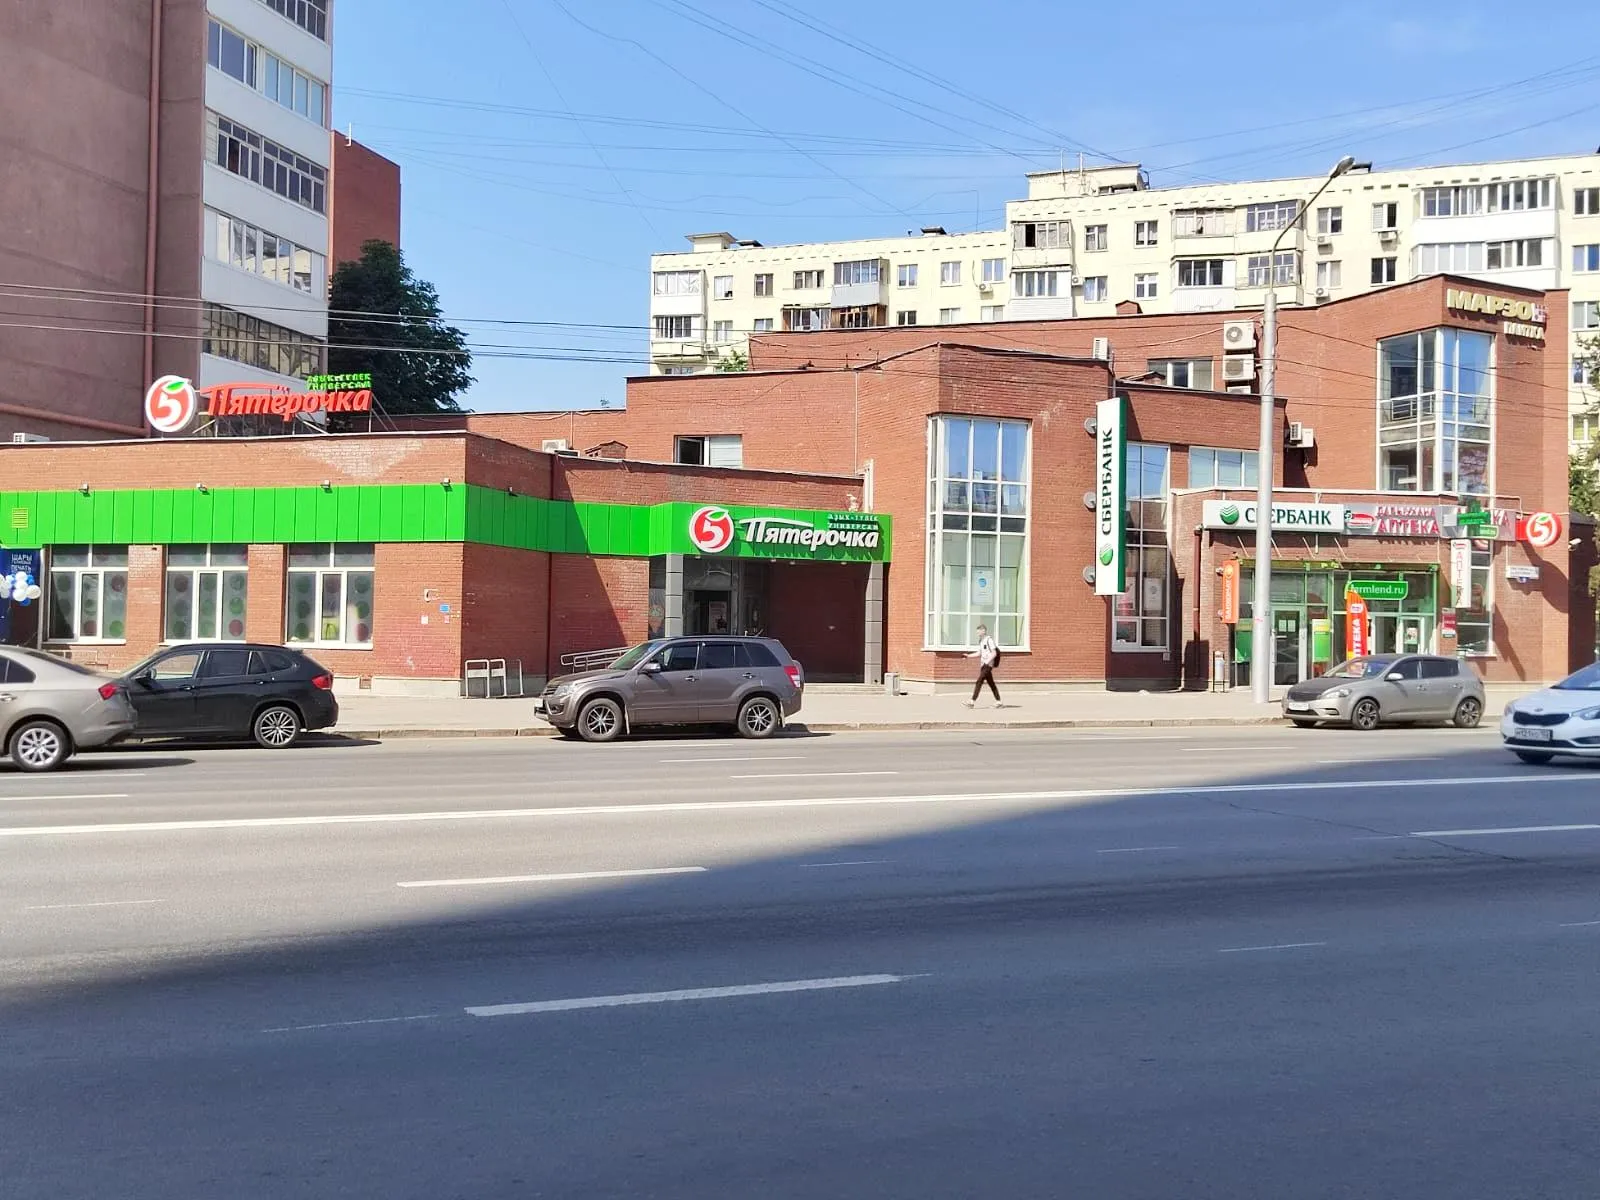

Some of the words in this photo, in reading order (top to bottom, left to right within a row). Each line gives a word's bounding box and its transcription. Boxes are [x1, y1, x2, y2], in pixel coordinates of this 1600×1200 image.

[1101, 427, 1113, 536] СБЕРБАНК
[1245, 507, 1332, 525] СЕРБАНК
[1376, 519, 1440, 535] АПТЕКА
[1352, 618, 1361, 657] ПТЕКА
